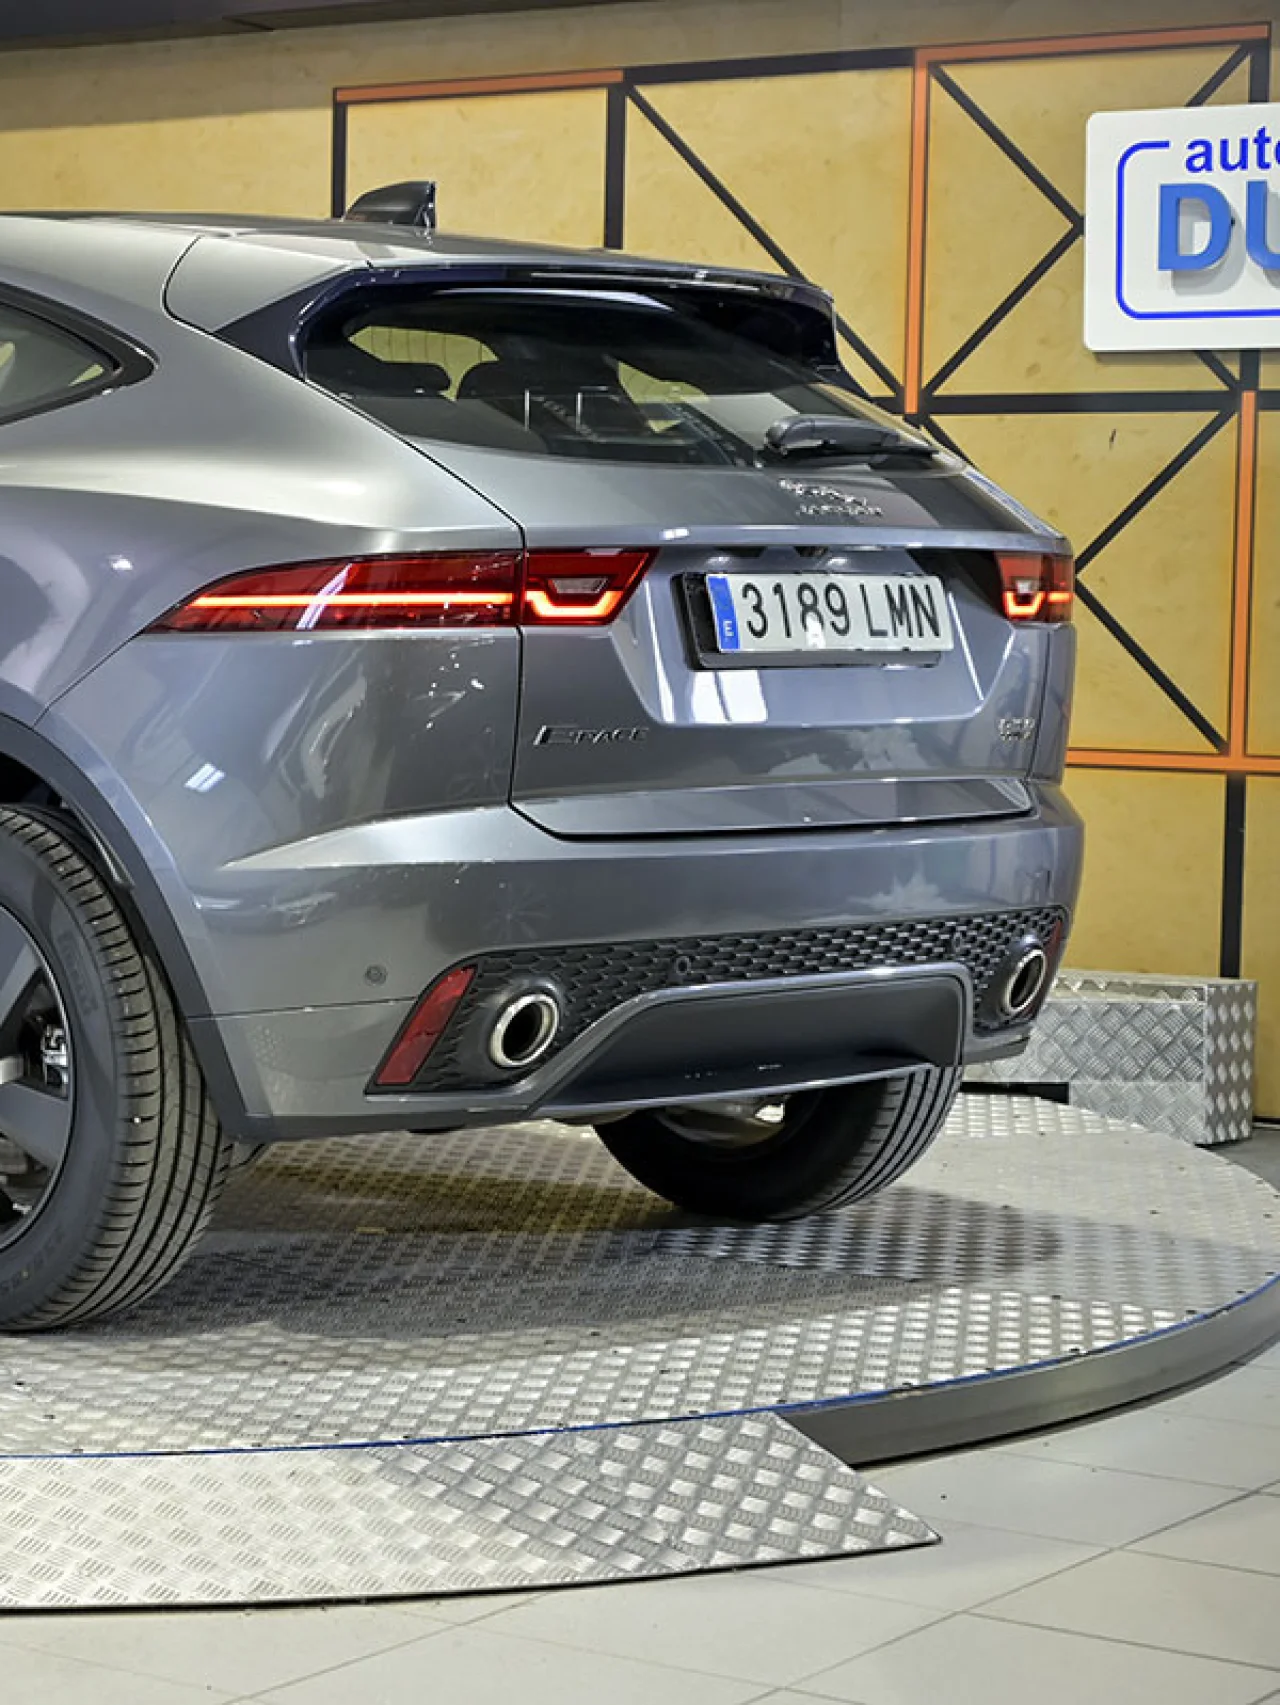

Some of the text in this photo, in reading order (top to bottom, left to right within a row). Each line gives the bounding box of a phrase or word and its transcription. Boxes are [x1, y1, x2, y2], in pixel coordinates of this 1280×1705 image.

[1185, 125, 1280, 173] aut
[723, 620, 735, 638] E
[741, 581, 941, 640] 3189 LMN
